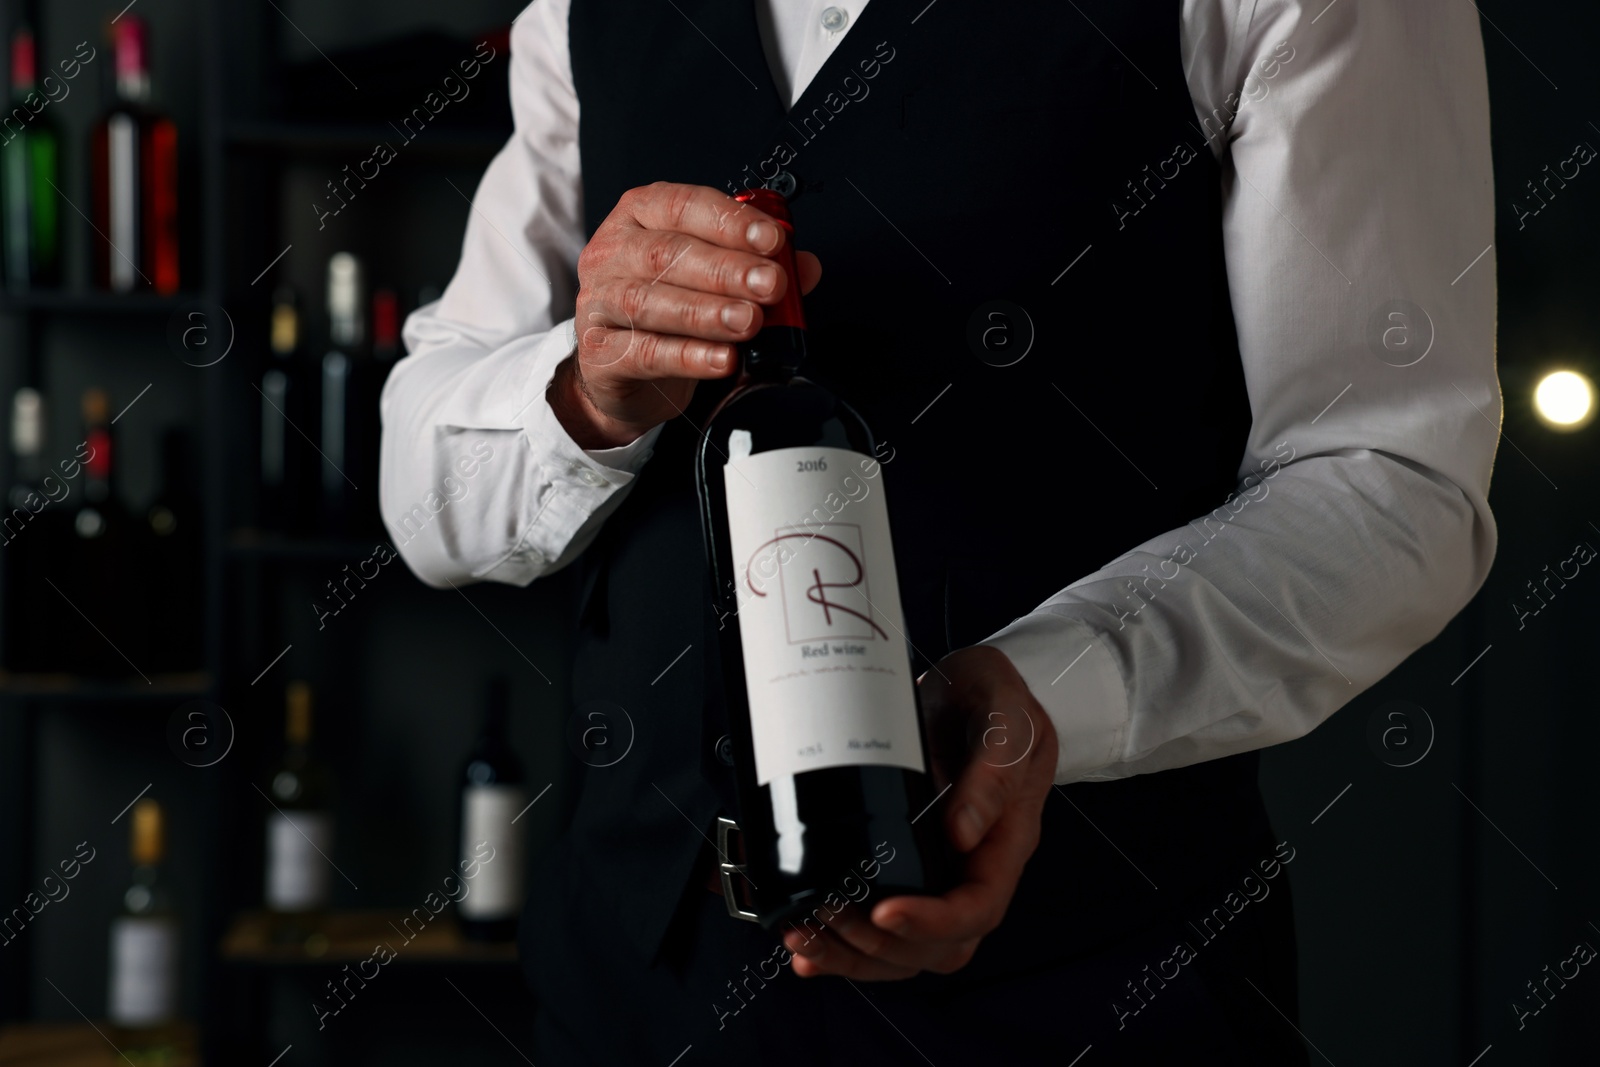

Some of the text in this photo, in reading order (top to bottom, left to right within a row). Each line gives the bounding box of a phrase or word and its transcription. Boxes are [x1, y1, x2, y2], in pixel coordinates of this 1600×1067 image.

[797, 456, 828, 472] 2016
[746, 532, 889, 641] R
[801, 641, 867, 659] Red wine
